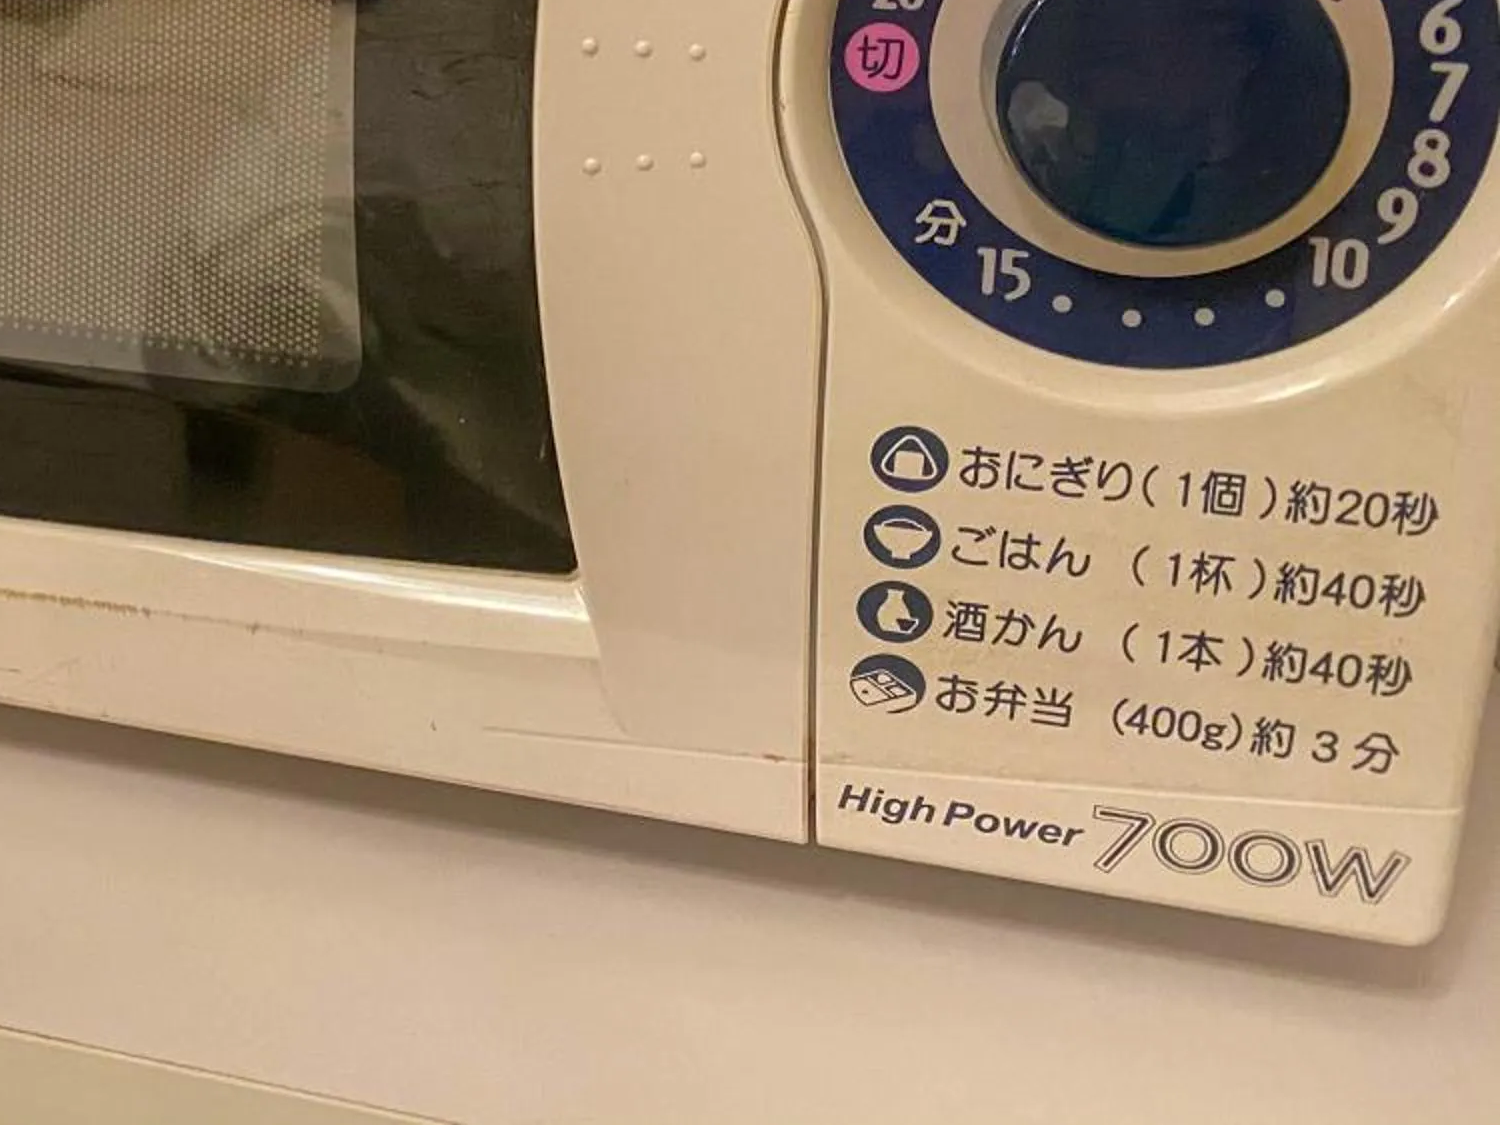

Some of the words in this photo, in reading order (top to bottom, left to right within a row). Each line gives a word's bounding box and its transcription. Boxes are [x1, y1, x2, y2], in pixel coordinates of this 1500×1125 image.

[857, 36, 906, 80] 切
[1430, 61, 1469, 122] 7
[1407, 129, 1451, 188] 8
[914, 198, 967, 246] 分
[1377, 187, 1419, 243] 9
[976, 246, 1032, 301] 15
[1309, 237, 1369, 290] 10
[950, 525, 1092, 579] ごはん
[942, 599, 1083, 655] 酒かん
[934, 673, 1074, 729] お弁当
[837, 783, 936, 826] High
[942, 801, 1086, 848] Power
[1092, 803, 1412, 906] 700W
